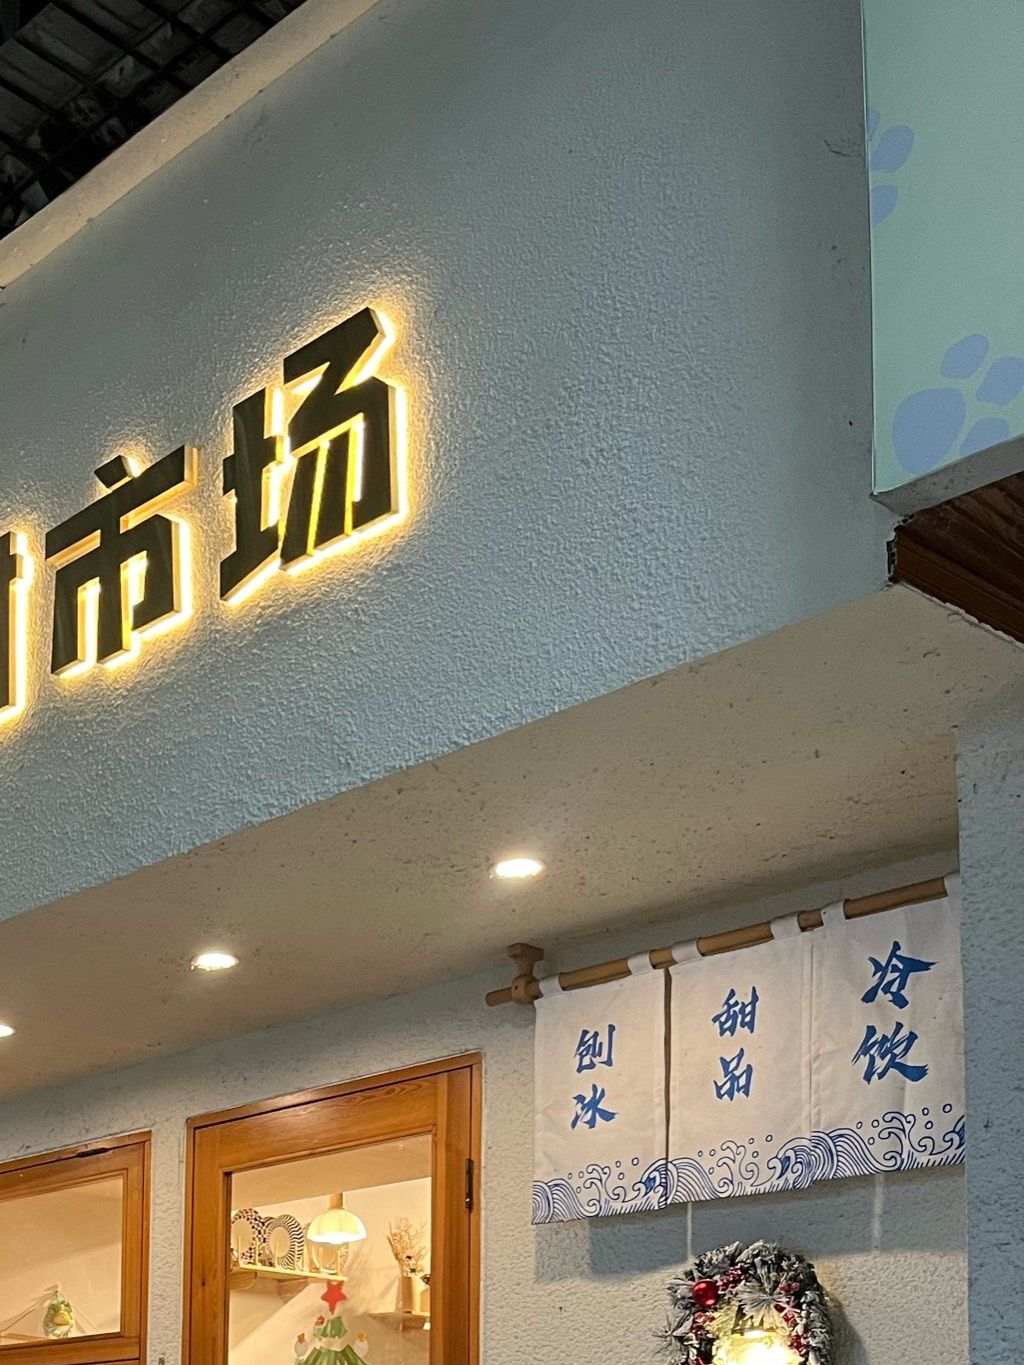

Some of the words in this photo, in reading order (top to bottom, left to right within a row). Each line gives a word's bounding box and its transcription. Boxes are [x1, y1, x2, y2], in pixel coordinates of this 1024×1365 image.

[711, 985, 760, 1101] 甜品
[851, 940, 937, 1085] 冷饮
[570, 1023, 618, 1130] 刨冰
